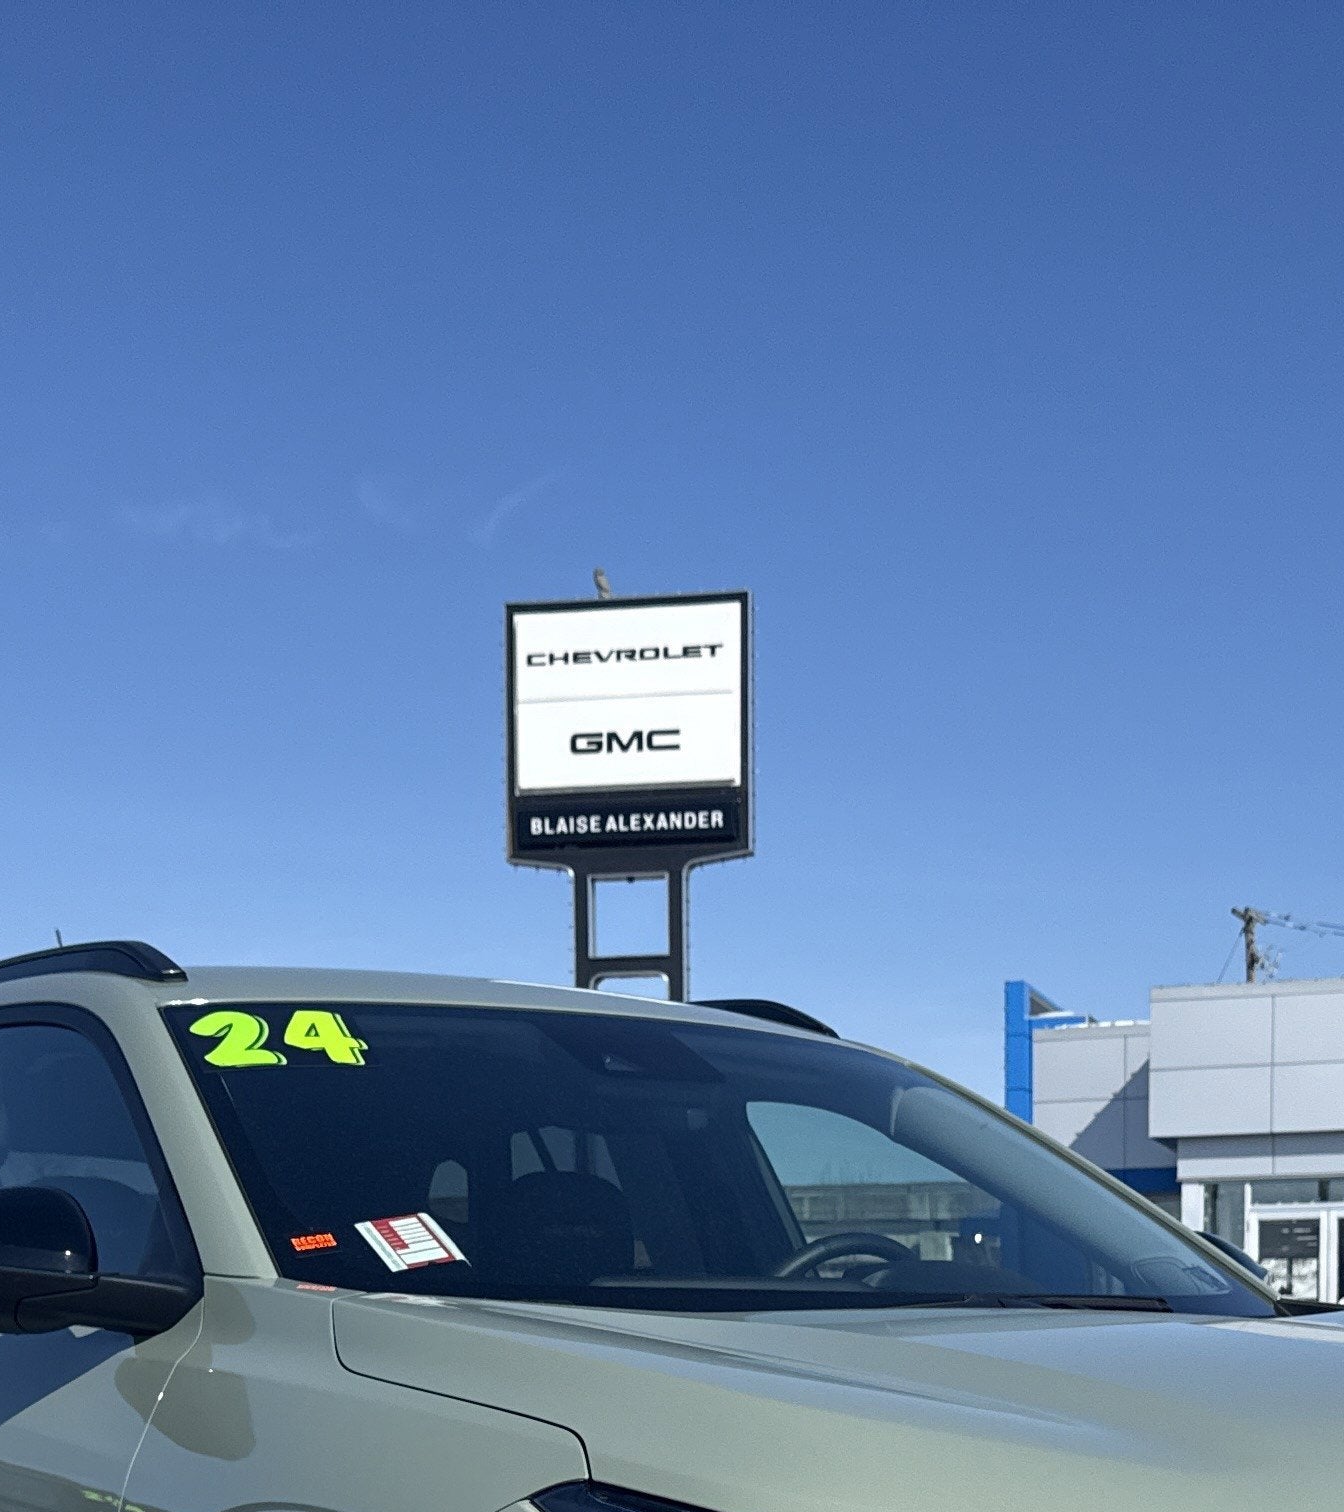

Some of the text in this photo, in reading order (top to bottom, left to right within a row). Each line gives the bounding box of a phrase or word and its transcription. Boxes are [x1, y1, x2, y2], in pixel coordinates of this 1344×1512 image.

[526, 643, 724, 667] CHEVROLET
[570, 729, 681, 755] GMC
[530, 810, 724, 836] BLAISE ALEXANDER
[190, 1010, 369, 1067] 24
